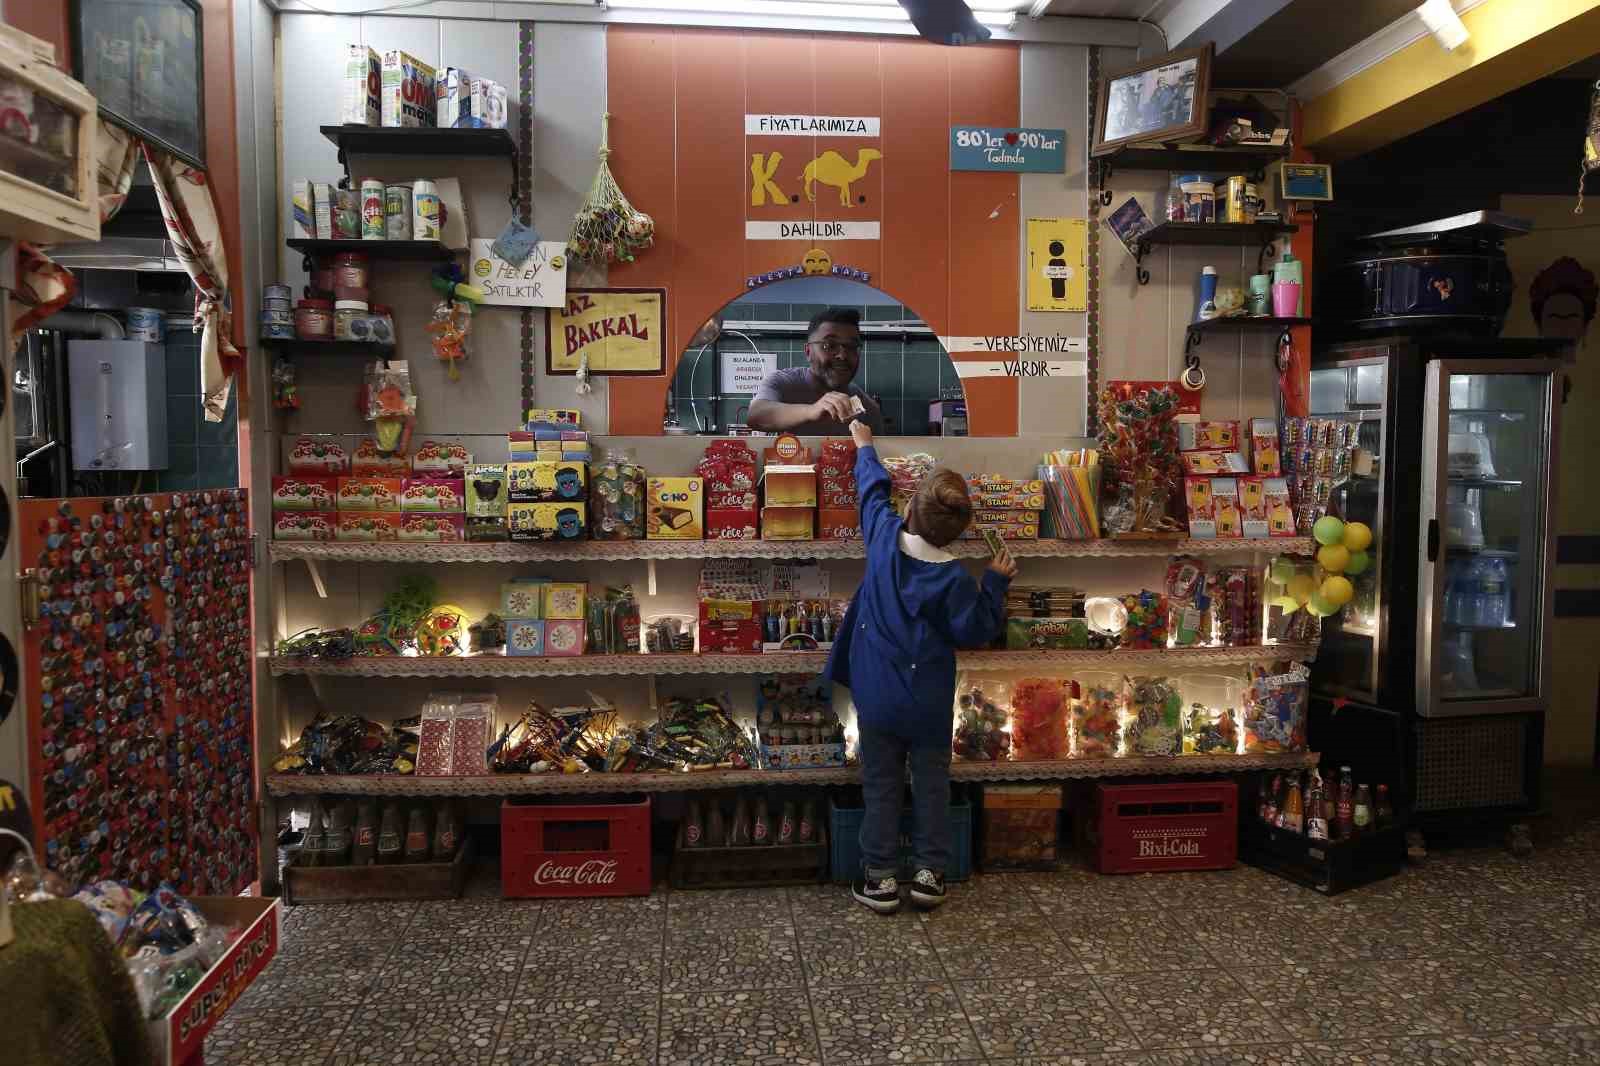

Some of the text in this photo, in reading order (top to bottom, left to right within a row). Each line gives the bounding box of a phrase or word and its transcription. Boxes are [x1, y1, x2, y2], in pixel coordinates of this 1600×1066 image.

[760, 116, 867, 132] FİYATLARIMIZA
[957, 130, 1004, 147] 80'ler
[564, 312, 649, 357] BAKKAL
[533, 859, 618, 886] Coca-Cola
